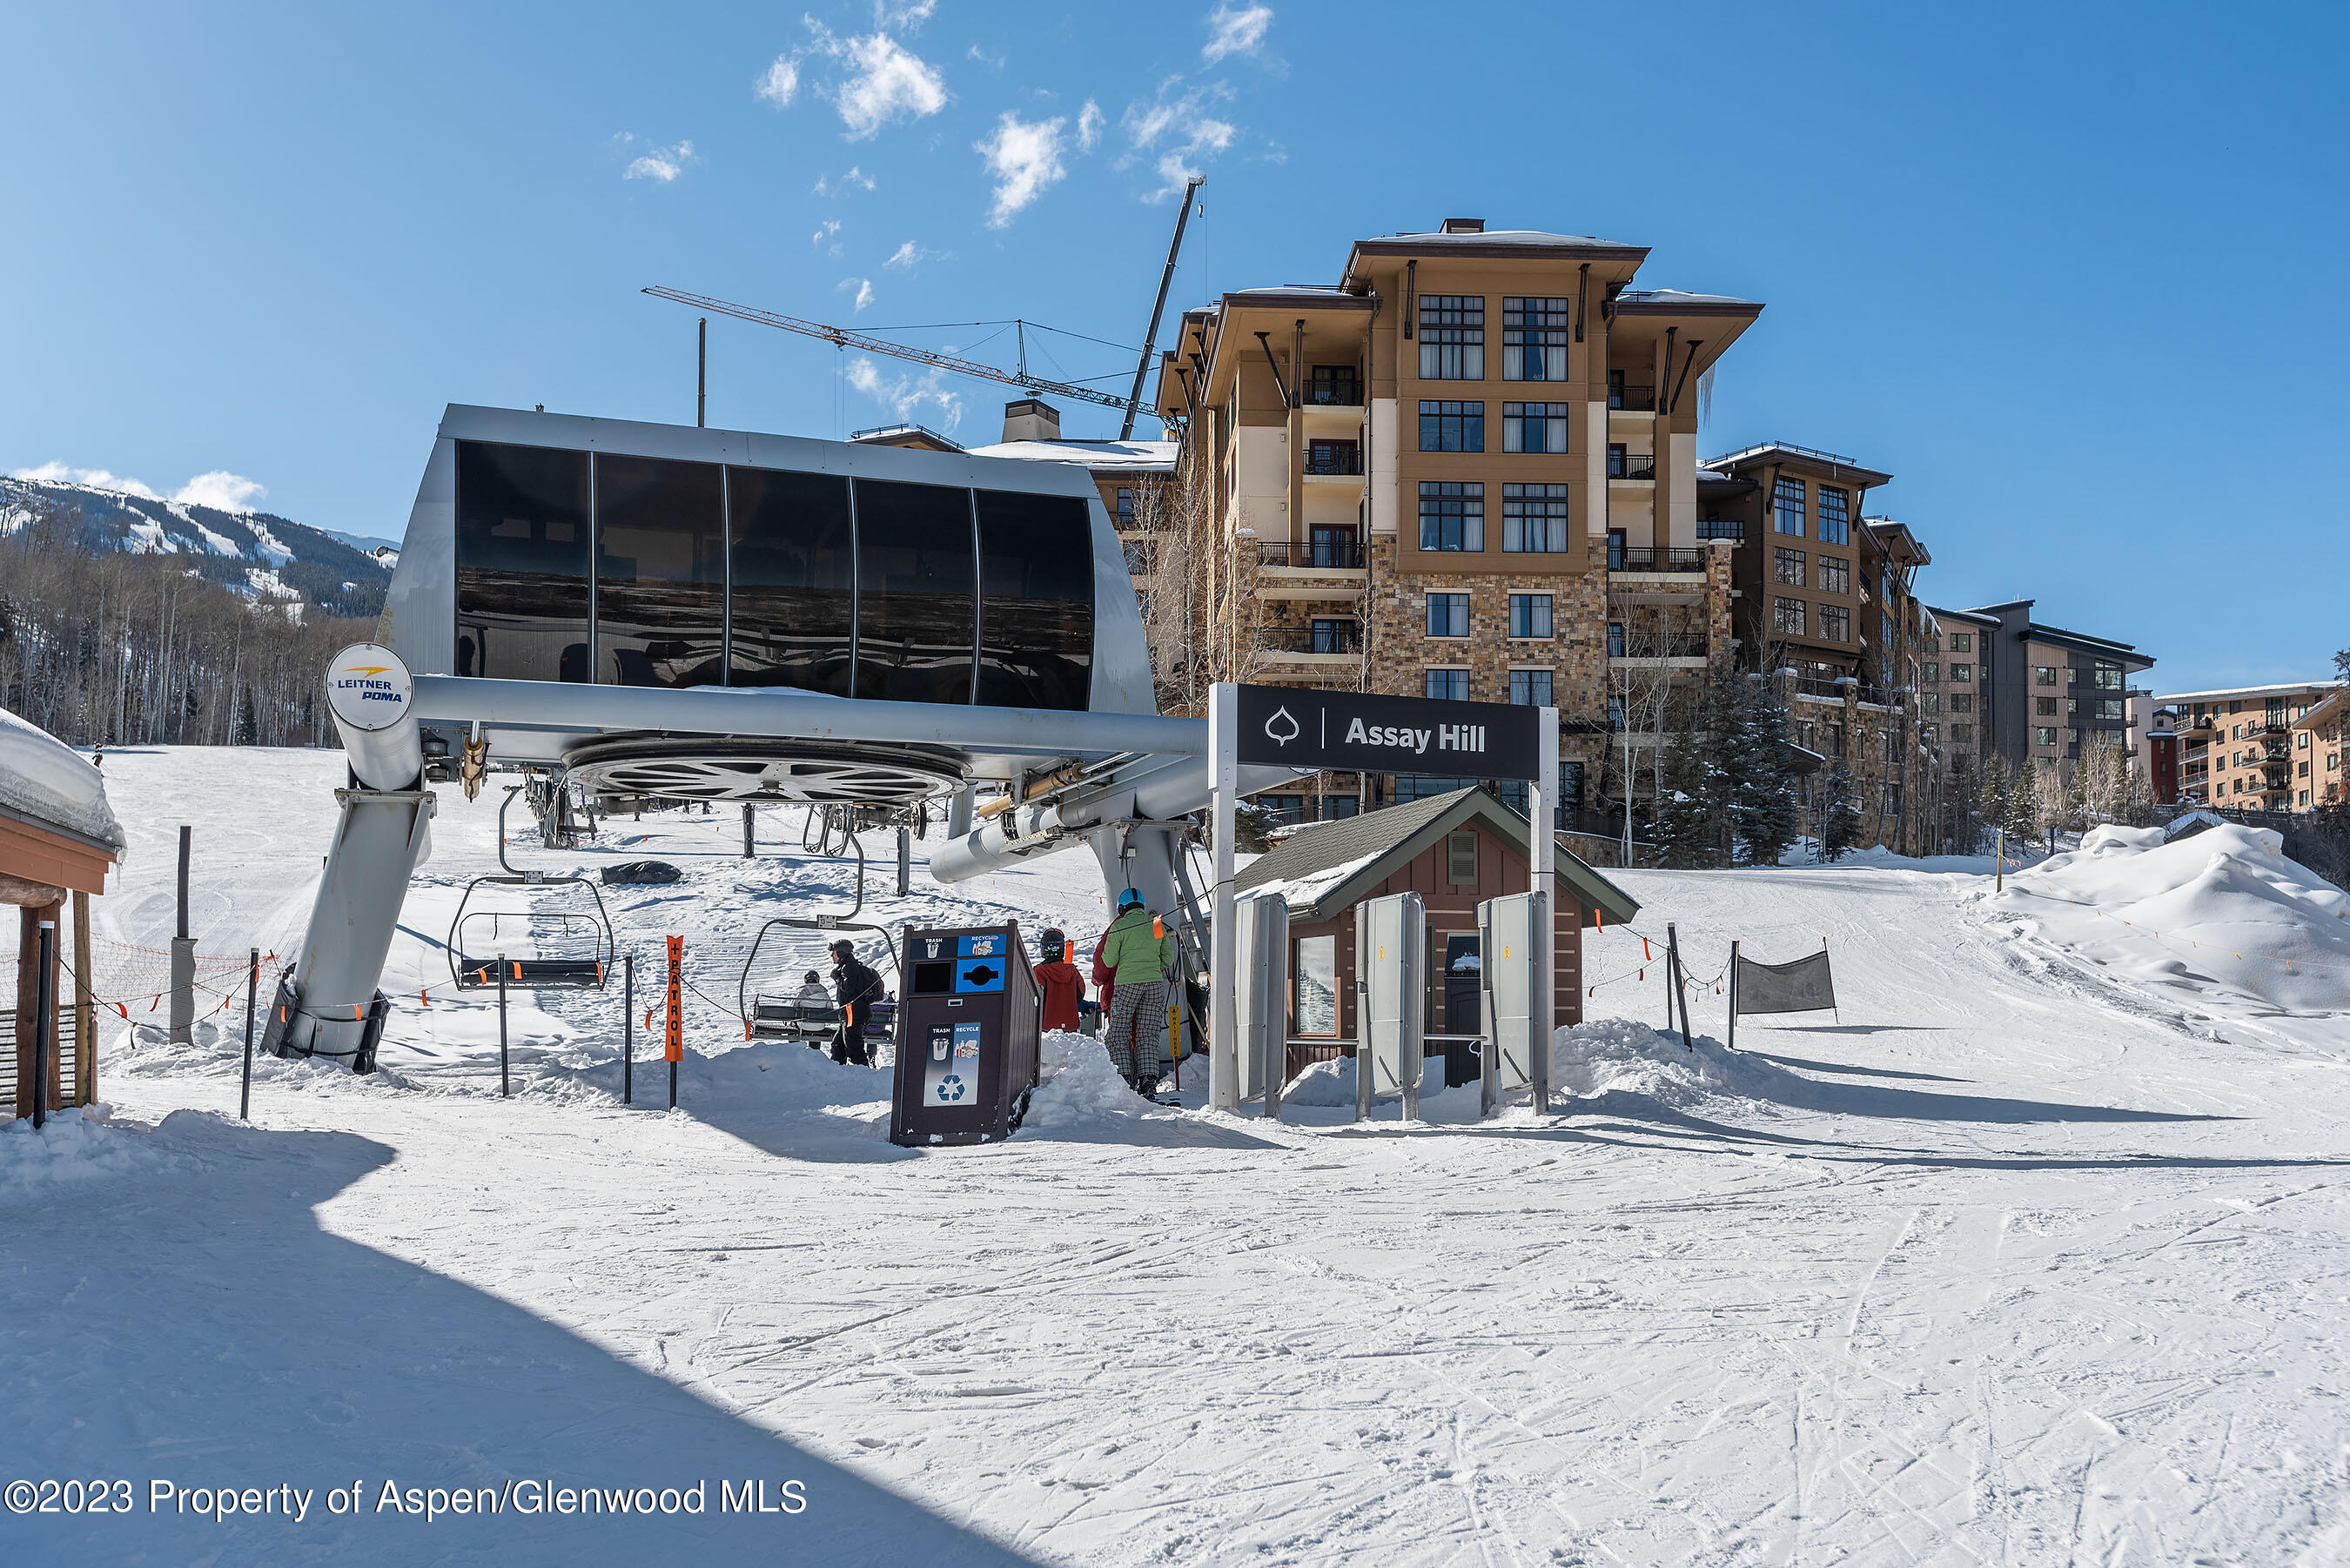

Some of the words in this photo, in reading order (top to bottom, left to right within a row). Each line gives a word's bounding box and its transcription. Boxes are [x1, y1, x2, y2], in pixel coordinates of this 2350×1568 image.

[338, 680, 392, 690] LEITNER
[362, 691, 402, 702] POMA
[1346, 717, 1432, 754] Assay
[1439, 723, 1485, 753] Hill
[670, 959, 679, 1046] PATROL
